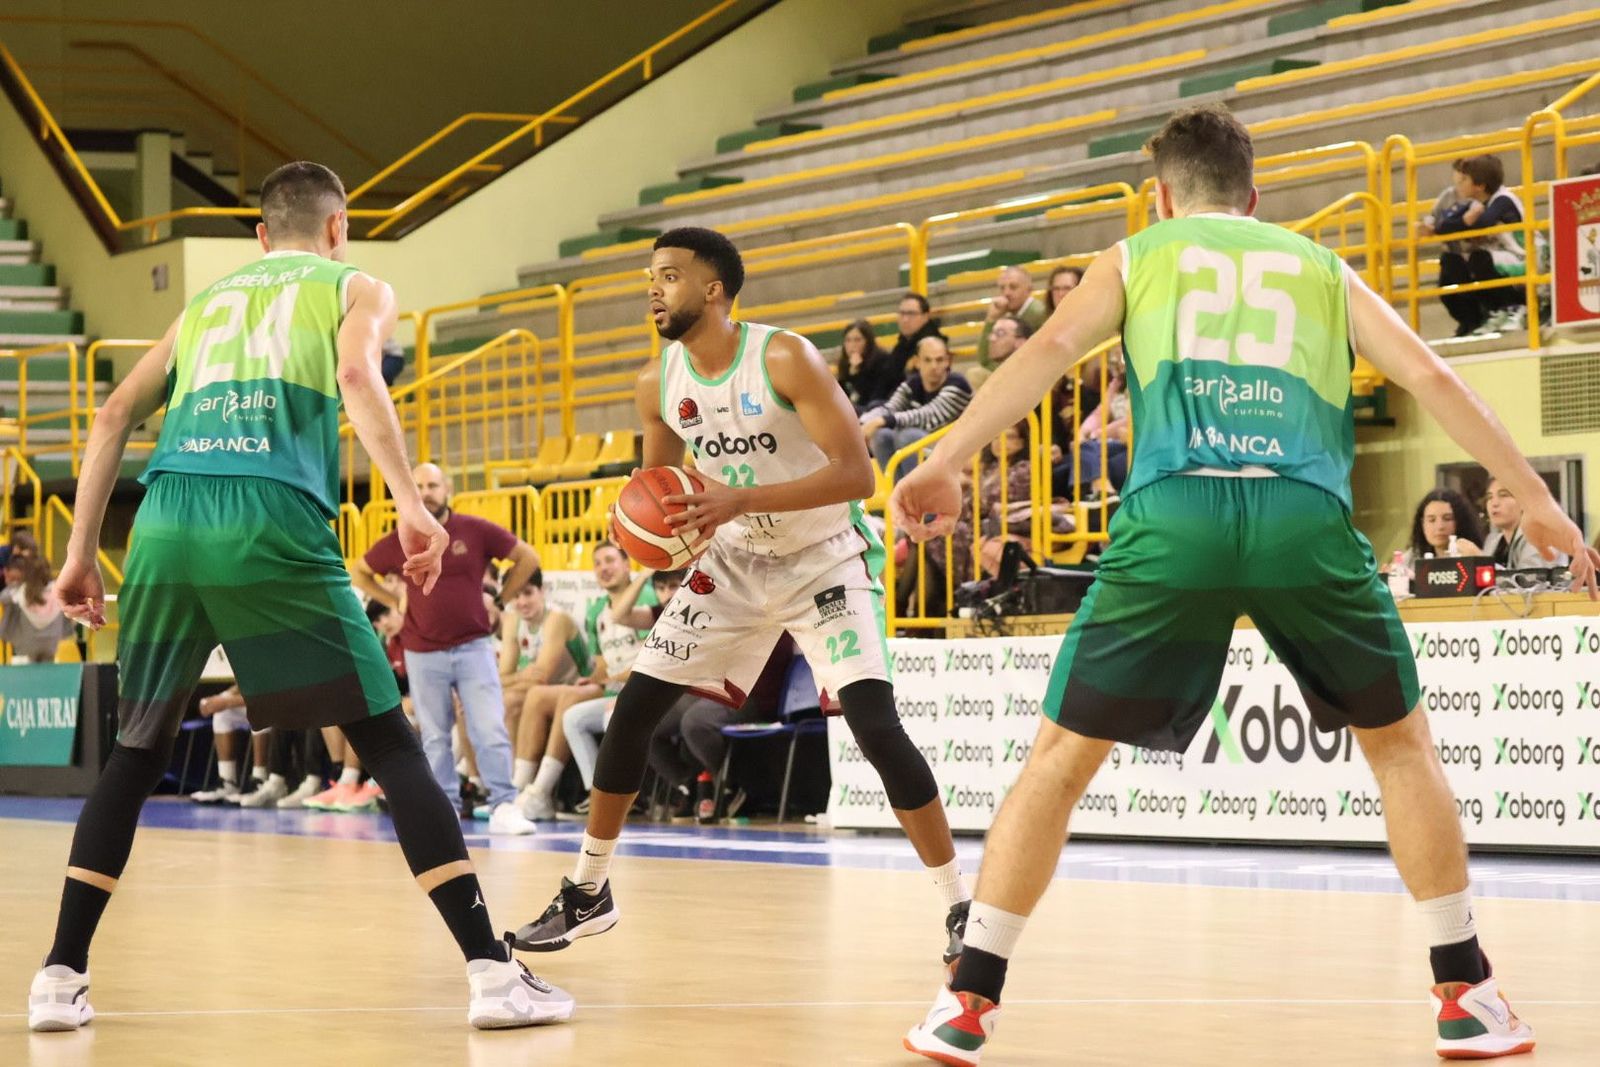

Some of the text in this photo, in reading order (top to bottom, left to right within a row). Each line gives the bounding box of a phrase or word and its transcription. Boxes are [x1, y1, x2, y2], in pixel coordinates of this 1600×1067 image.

[1177, 245, 1302, 369] 25
[191, 283, 299, 393] 24
[687, 431, 778, 459] Xoborg
[721, 463, 760, 489] 22
[1427, 570, 1459, 585] POSSE
[826, 629, 864, 665] 22
[944, 648, 994, 676] Xoborg
[1001, 646, 1051, 675] Xoborg
[1414, 631, 1480, 664] Xoborg
[1492, 628, 1563, 662] Xoborg
[6, 697, 37, 737] CAJA
[944, 693, 994, 722] Xoborg
[1492, 682, 1564, 717] Xoborg
[943, 738, 994, 768] Xoborg
[1493, 736, 1565, 772] Xoborg
[837, 784, 885, 814] Xoborg
[944, 784, 995, 815] Xoborg
[1127, 788, 1187, 820] Xoborg
[1199, 788, 1257, 821] Xoborg
[1266, 788, 1327, 822] Xoborg
[1494, 790, 1566, 827] Xoborg
